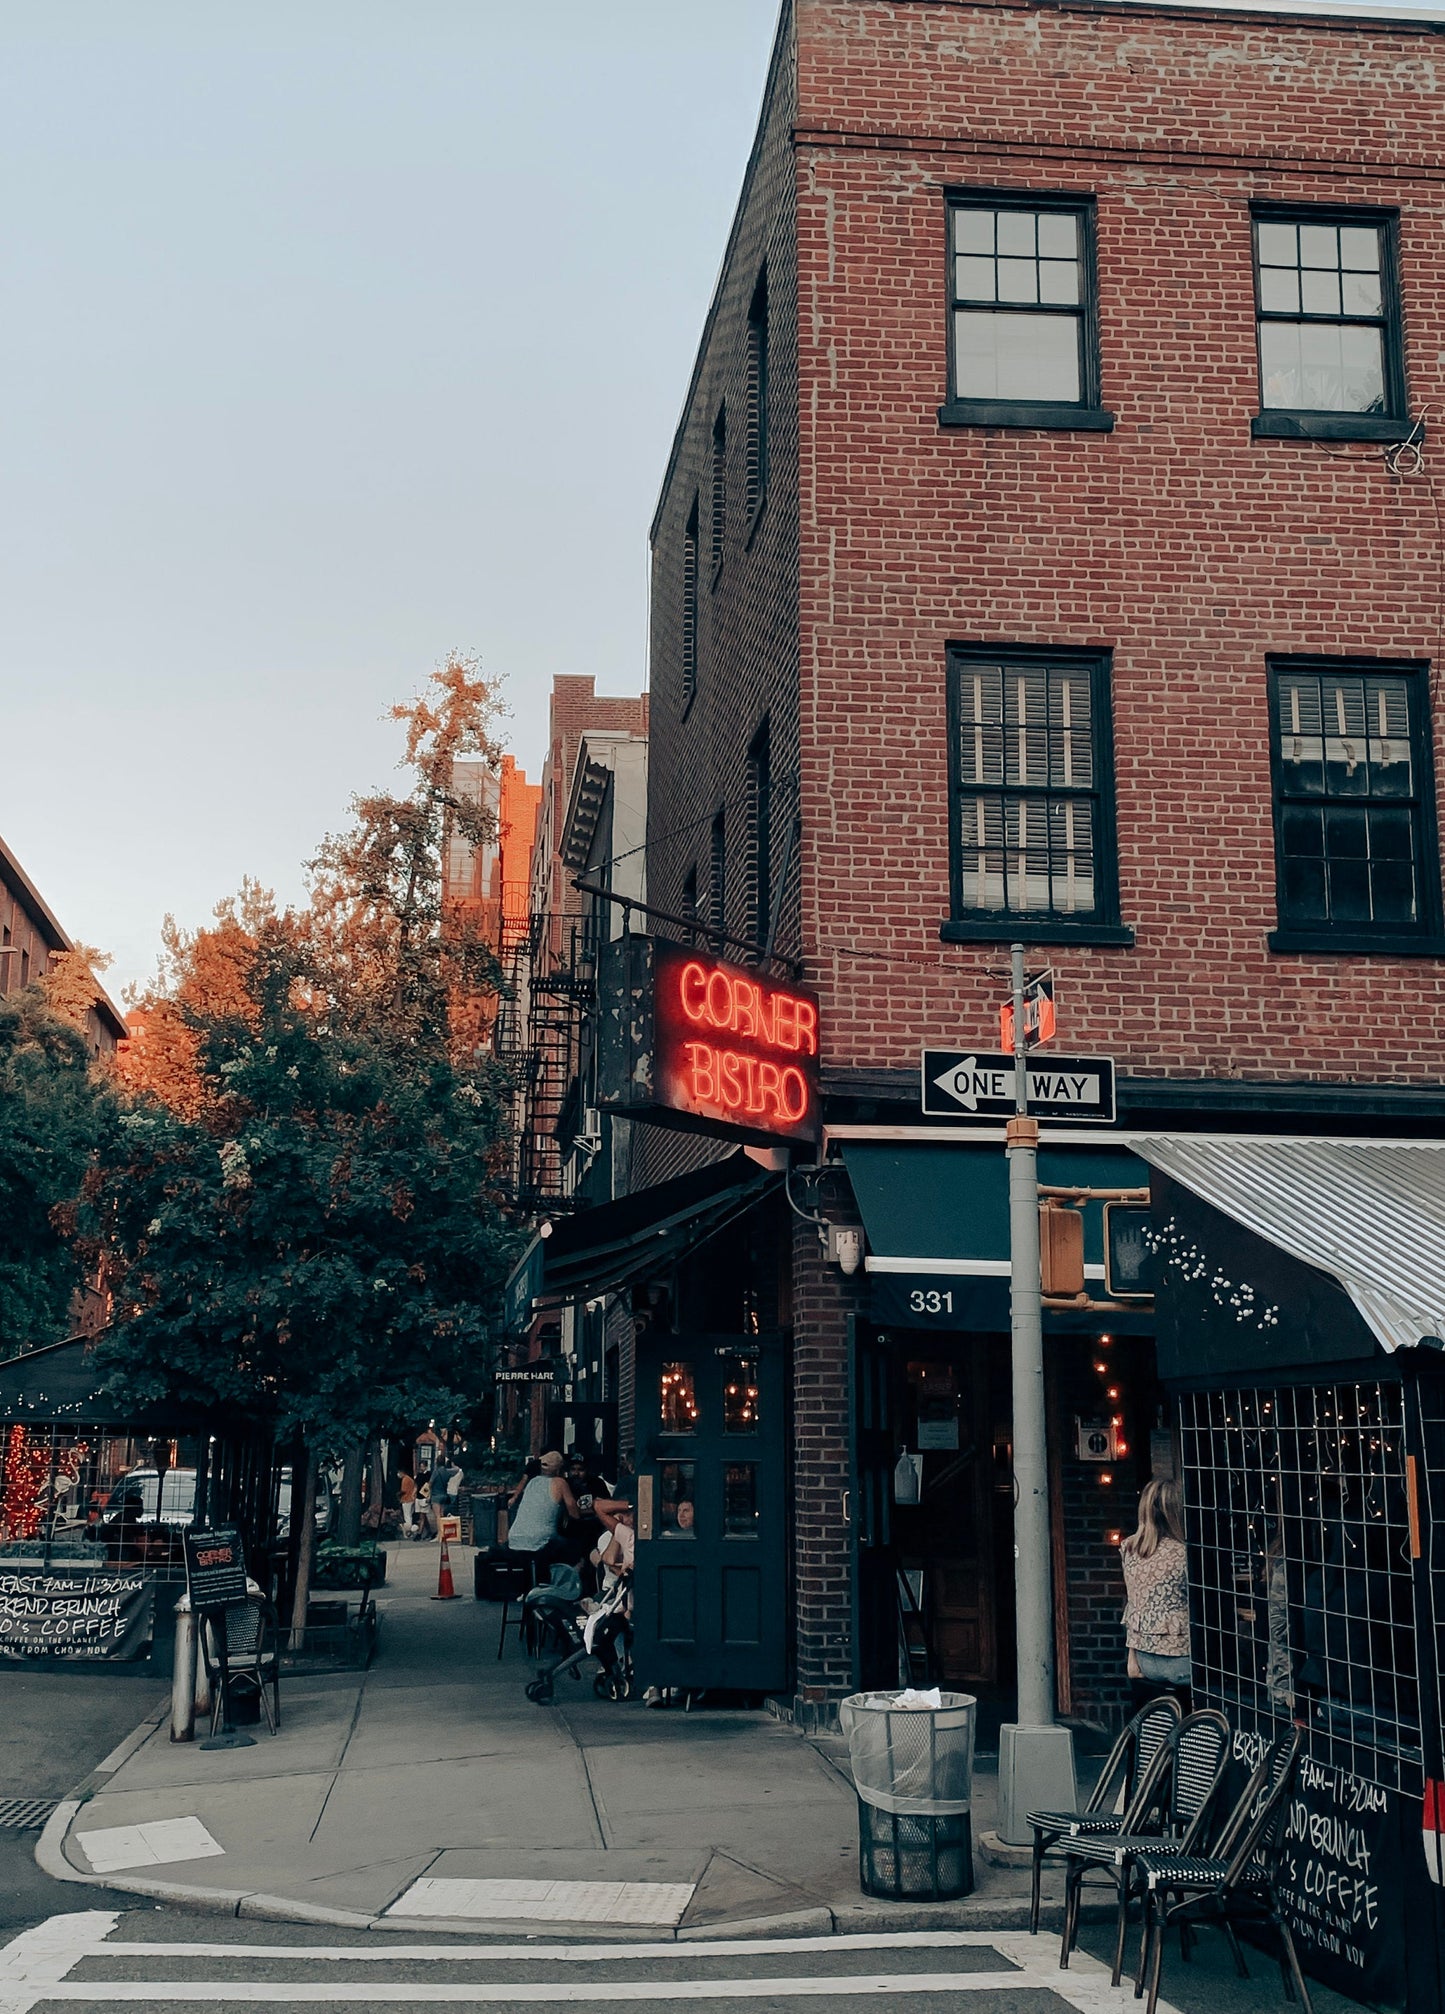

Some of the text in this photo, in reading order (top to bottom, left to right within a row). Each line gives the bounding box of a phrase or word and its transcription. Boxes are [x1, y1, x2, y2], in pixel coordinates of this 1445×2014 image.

[681, 963, 816, 1055] CORNER
[684, 1042, 807, 1121] BISTRO
[953, 1071, 1089, 1100] ONE WAY
[910, 1290, 953, 1313] 331
[495, 1372, 530, 1380] PIERRE
[42, 1577, 143, 1594] 7AM-11:30AM
[51, 1598, 121, 1617] BRUNCH
[41, 1617, 128, 1638] COFFEE
[21, 1646, 49, 1654] FROM
[54, 1647, 82, 1655] CHOW
[87, 1647, 109, 1655] NOW
[1299, 1754, 1388, 1814] 7AM-11:30AM
[1309, 1813, 1371, 1876] BRUNCH
[1304, 1859, 1378, 1930] COFFEE
